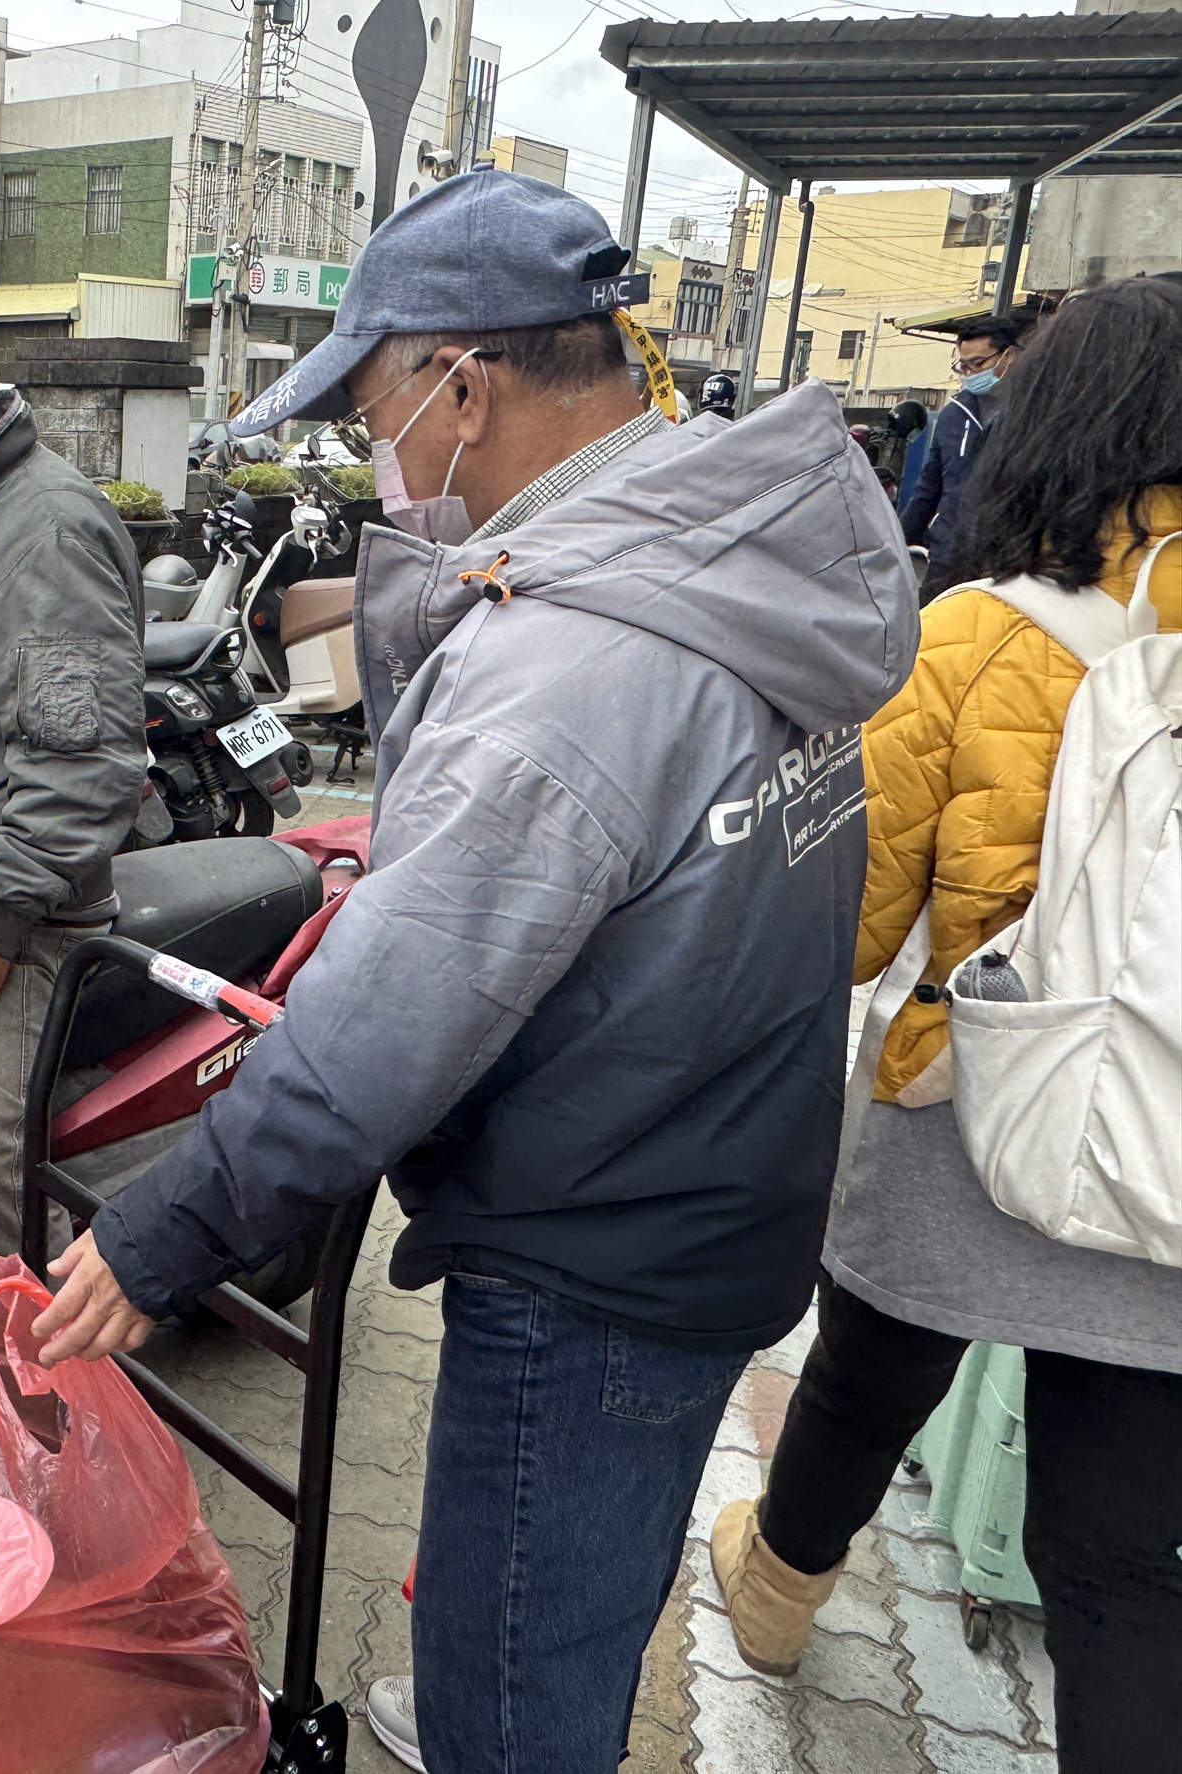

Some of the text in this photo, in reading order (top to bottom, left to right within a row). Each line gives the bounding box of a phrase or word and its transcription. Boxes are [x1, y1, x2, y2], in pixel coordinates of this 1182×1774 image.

[272, 267, 311, 296] 郵局
[326, 282, 344, 301] PO
[592, 280, 631, 308] HAC
[226, 716, 284, 759] MRF-6791
[197, 1033, 263, 1086] GT12
